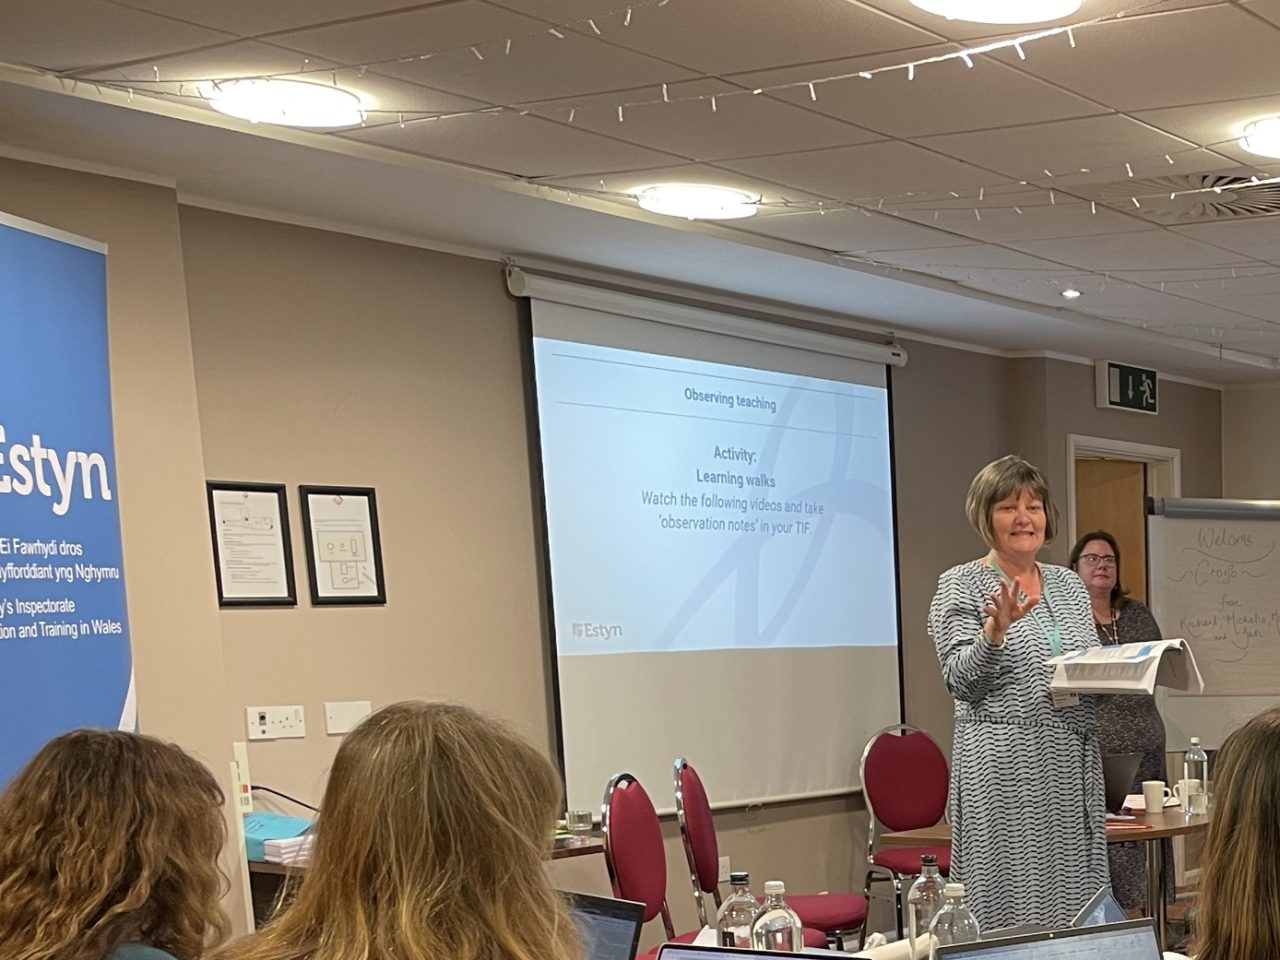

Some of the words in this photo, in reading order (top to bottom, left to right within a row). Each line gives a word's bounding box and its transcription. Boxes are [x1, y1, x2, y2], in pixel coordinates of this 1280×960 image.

[684, 387, 734, 408] Observing
[736, 394, 777, 414] teaching
[713, 445, 757, 465] Activity:
[696, 468, 744, 489] Learning
[746, 473, 776, 488] walks
[641, 490, 677, 507] Watch
[680, 491, 698, 508] the
[701, 492, 748, 513] following
[750, 496, 783, 513] videos
[785, 500, 802, 514] and
[804, 501, 825, 516] take
[760, 519, 769, 533] in
[771, 522, 795, 537] your
[13, 538, 58, 559] Fawrhydi
[60, 540, 83, 556] dros
[55, 567, 74, 583] yng
[75, 563, 120, 583] Nghymru
[15, 598, 76, 618] Inspectorate
[18, 622, 38, 639] and
[38, 620, 79, 640] Training
[80, 620, 90, 635] in
[91, 619, 122, 635] Wales
[584, 622, 623, 640] Estyn
